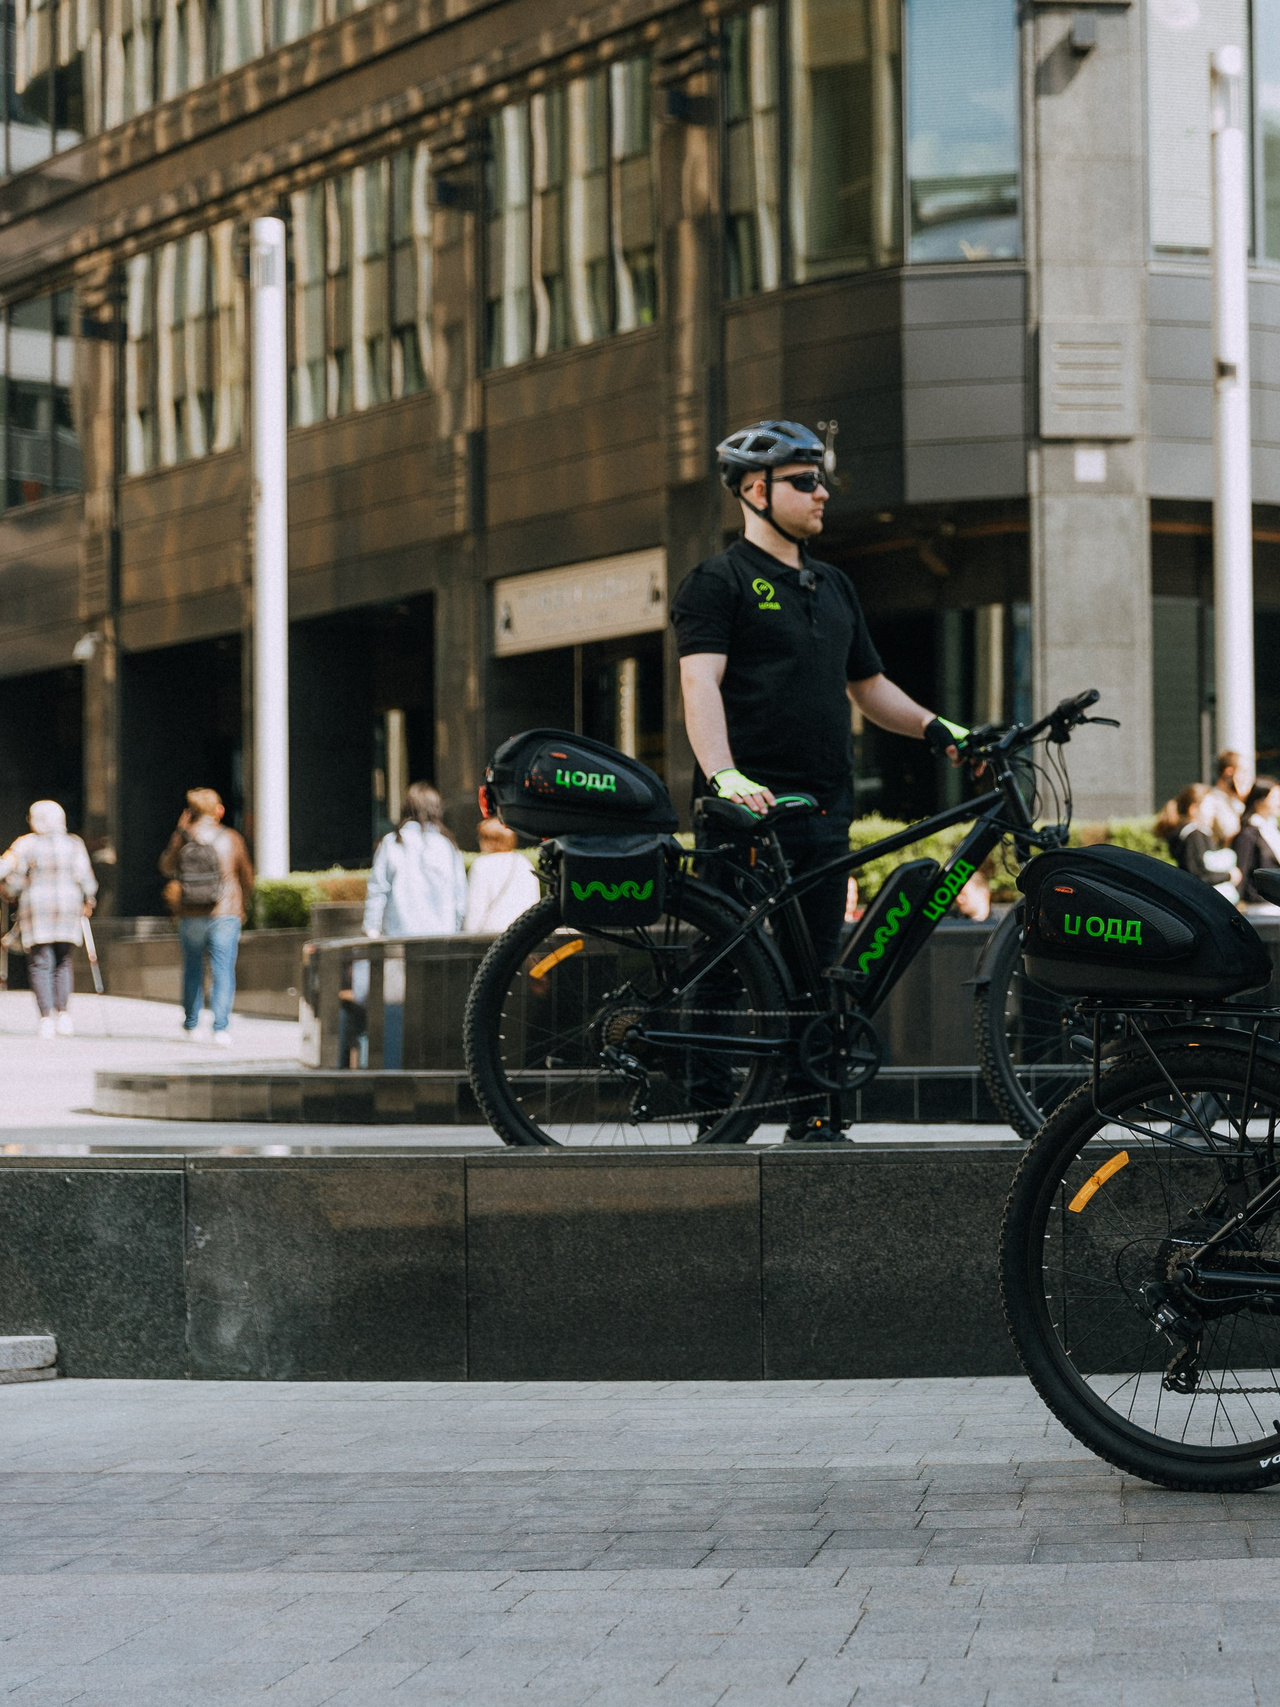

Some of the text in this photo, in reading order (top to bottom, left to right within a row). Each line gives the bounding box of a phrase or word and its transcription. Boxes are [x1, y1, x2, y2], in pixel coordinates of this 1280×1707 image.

[555, 769, 617, 793] ЦОДД
[922, 858, 976, 921] ЦОДД
[1064, 913, 1142, 945] ЦОДД
